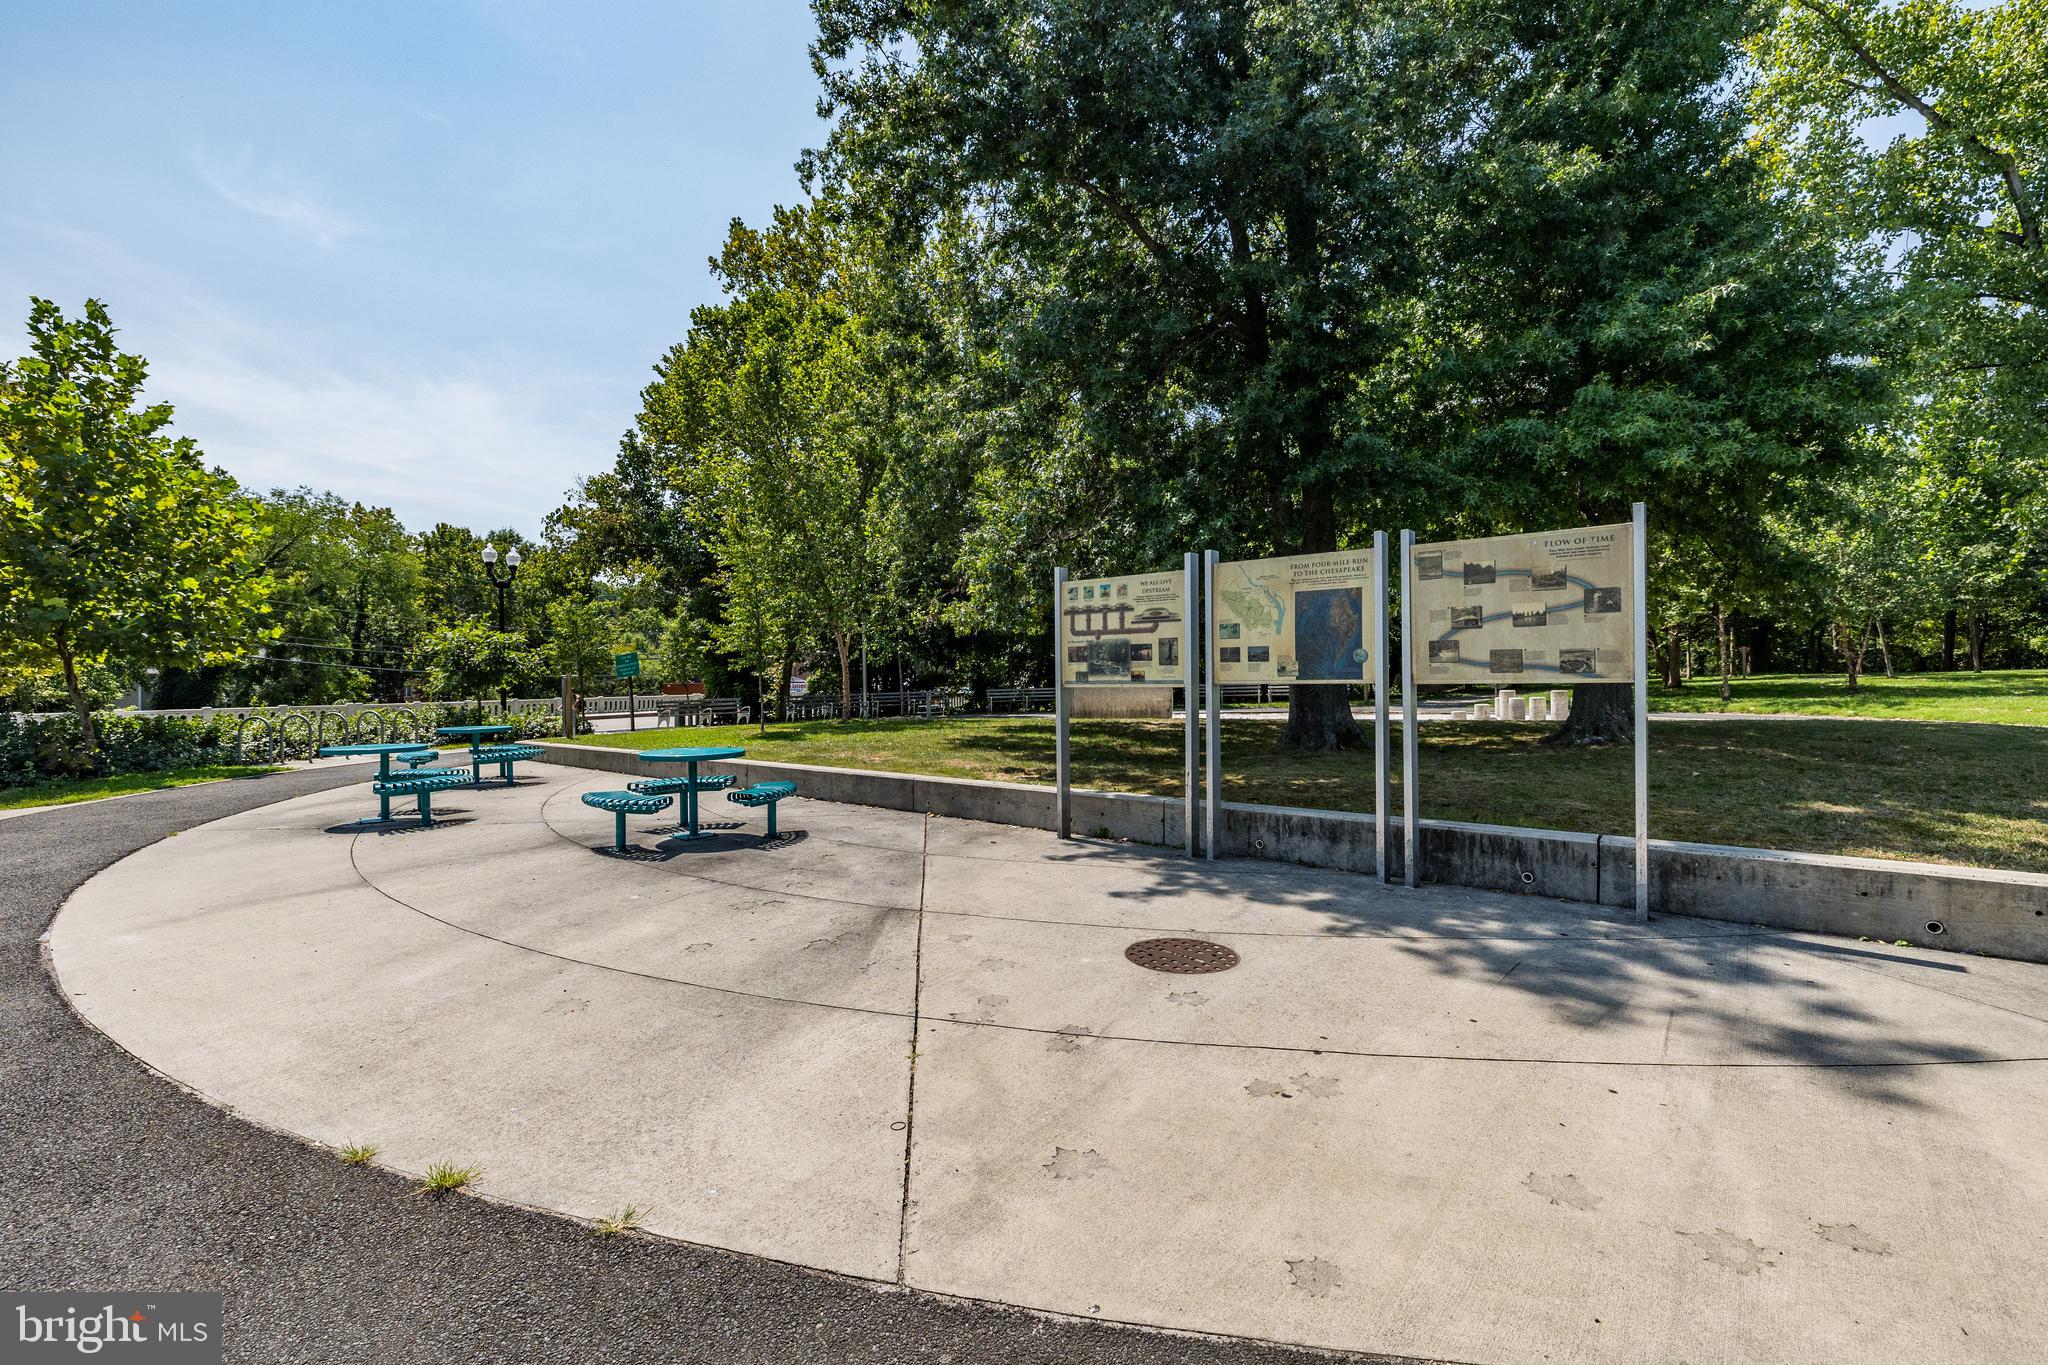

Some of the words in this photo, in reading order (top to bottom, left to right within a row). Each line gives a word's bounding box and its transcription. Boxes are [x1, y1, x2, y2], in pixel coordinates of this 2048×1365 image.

[1544, 539, 1571, 548] FLOW
[1573, 537, 1587, 545] OF
[1589, 534, 1616, 543] TIME
[1290, 562, 1310, 571] FROM
[1311, 560, 1331, 568] FOUR
[1333, 559, 1350, 567] MILE
[1352, 557, 1369, 565] RUN
[1319, 565, 1365, 575] CHESAPEAKE
